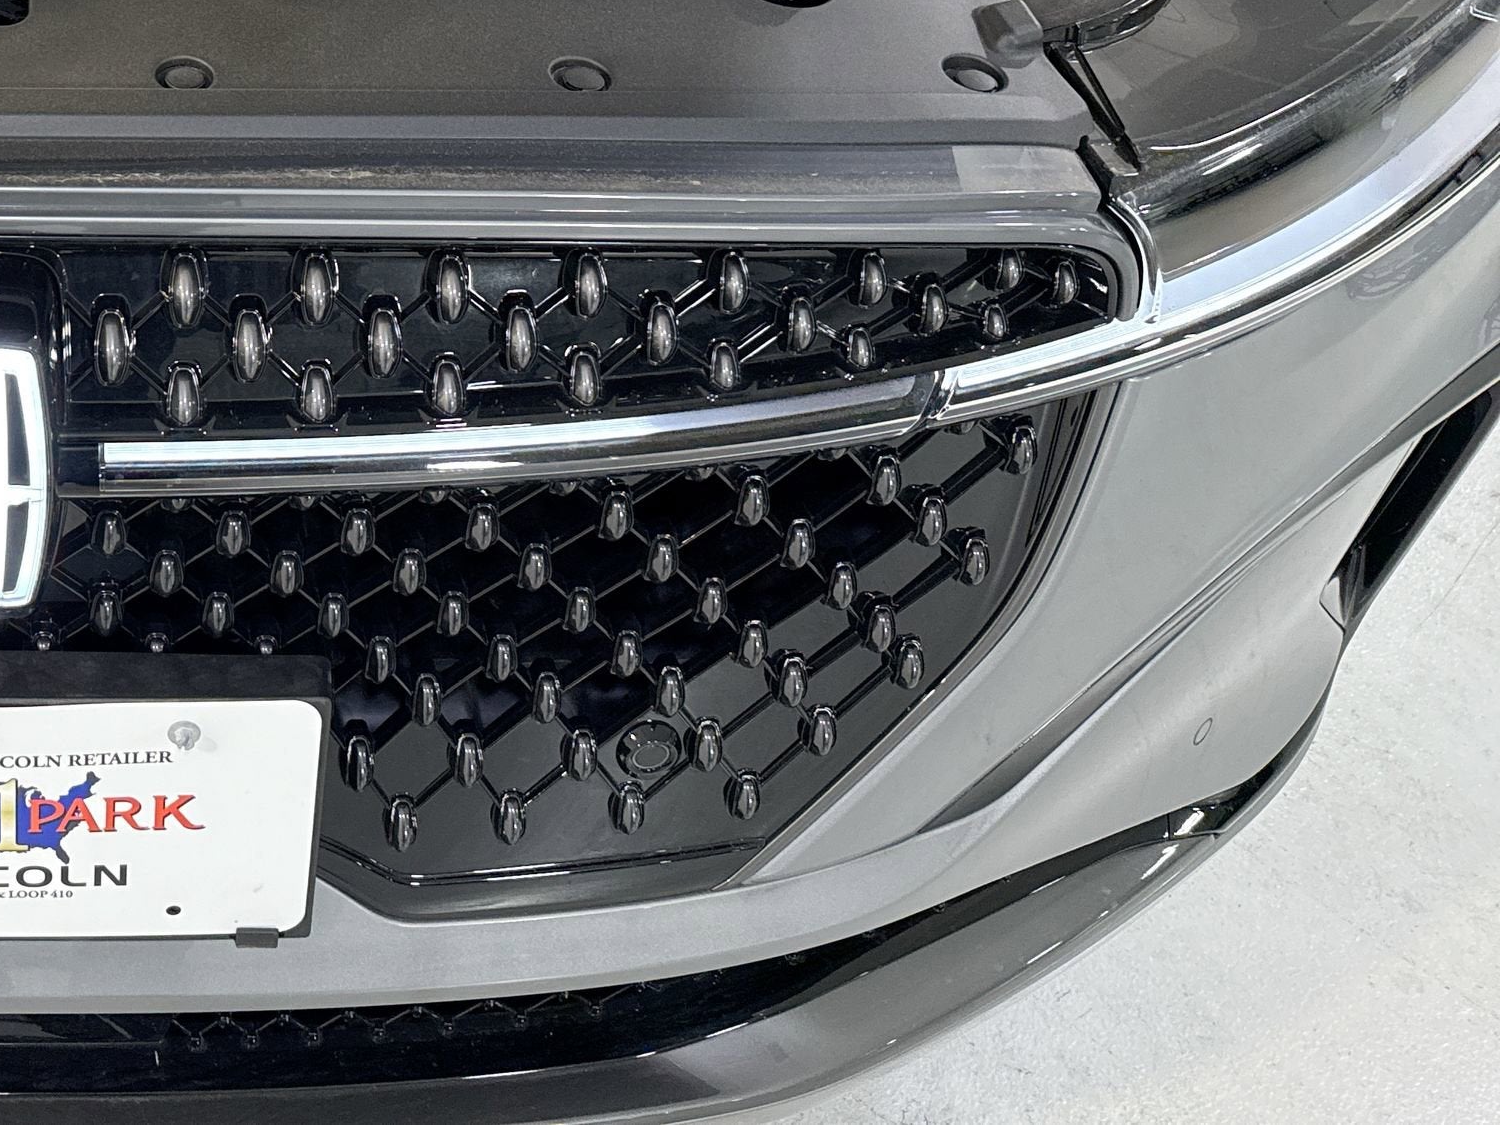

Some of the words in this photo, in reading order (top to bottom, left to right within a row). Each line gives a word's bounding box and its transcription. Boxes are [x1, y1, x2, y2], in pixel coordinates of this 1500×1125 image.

[67, 750, 173, 767] RETAILER
[27, 793, 205, 833] PARK
[9, 890, 48, 898] LOOP
[50, 890, 74, 898] 410
